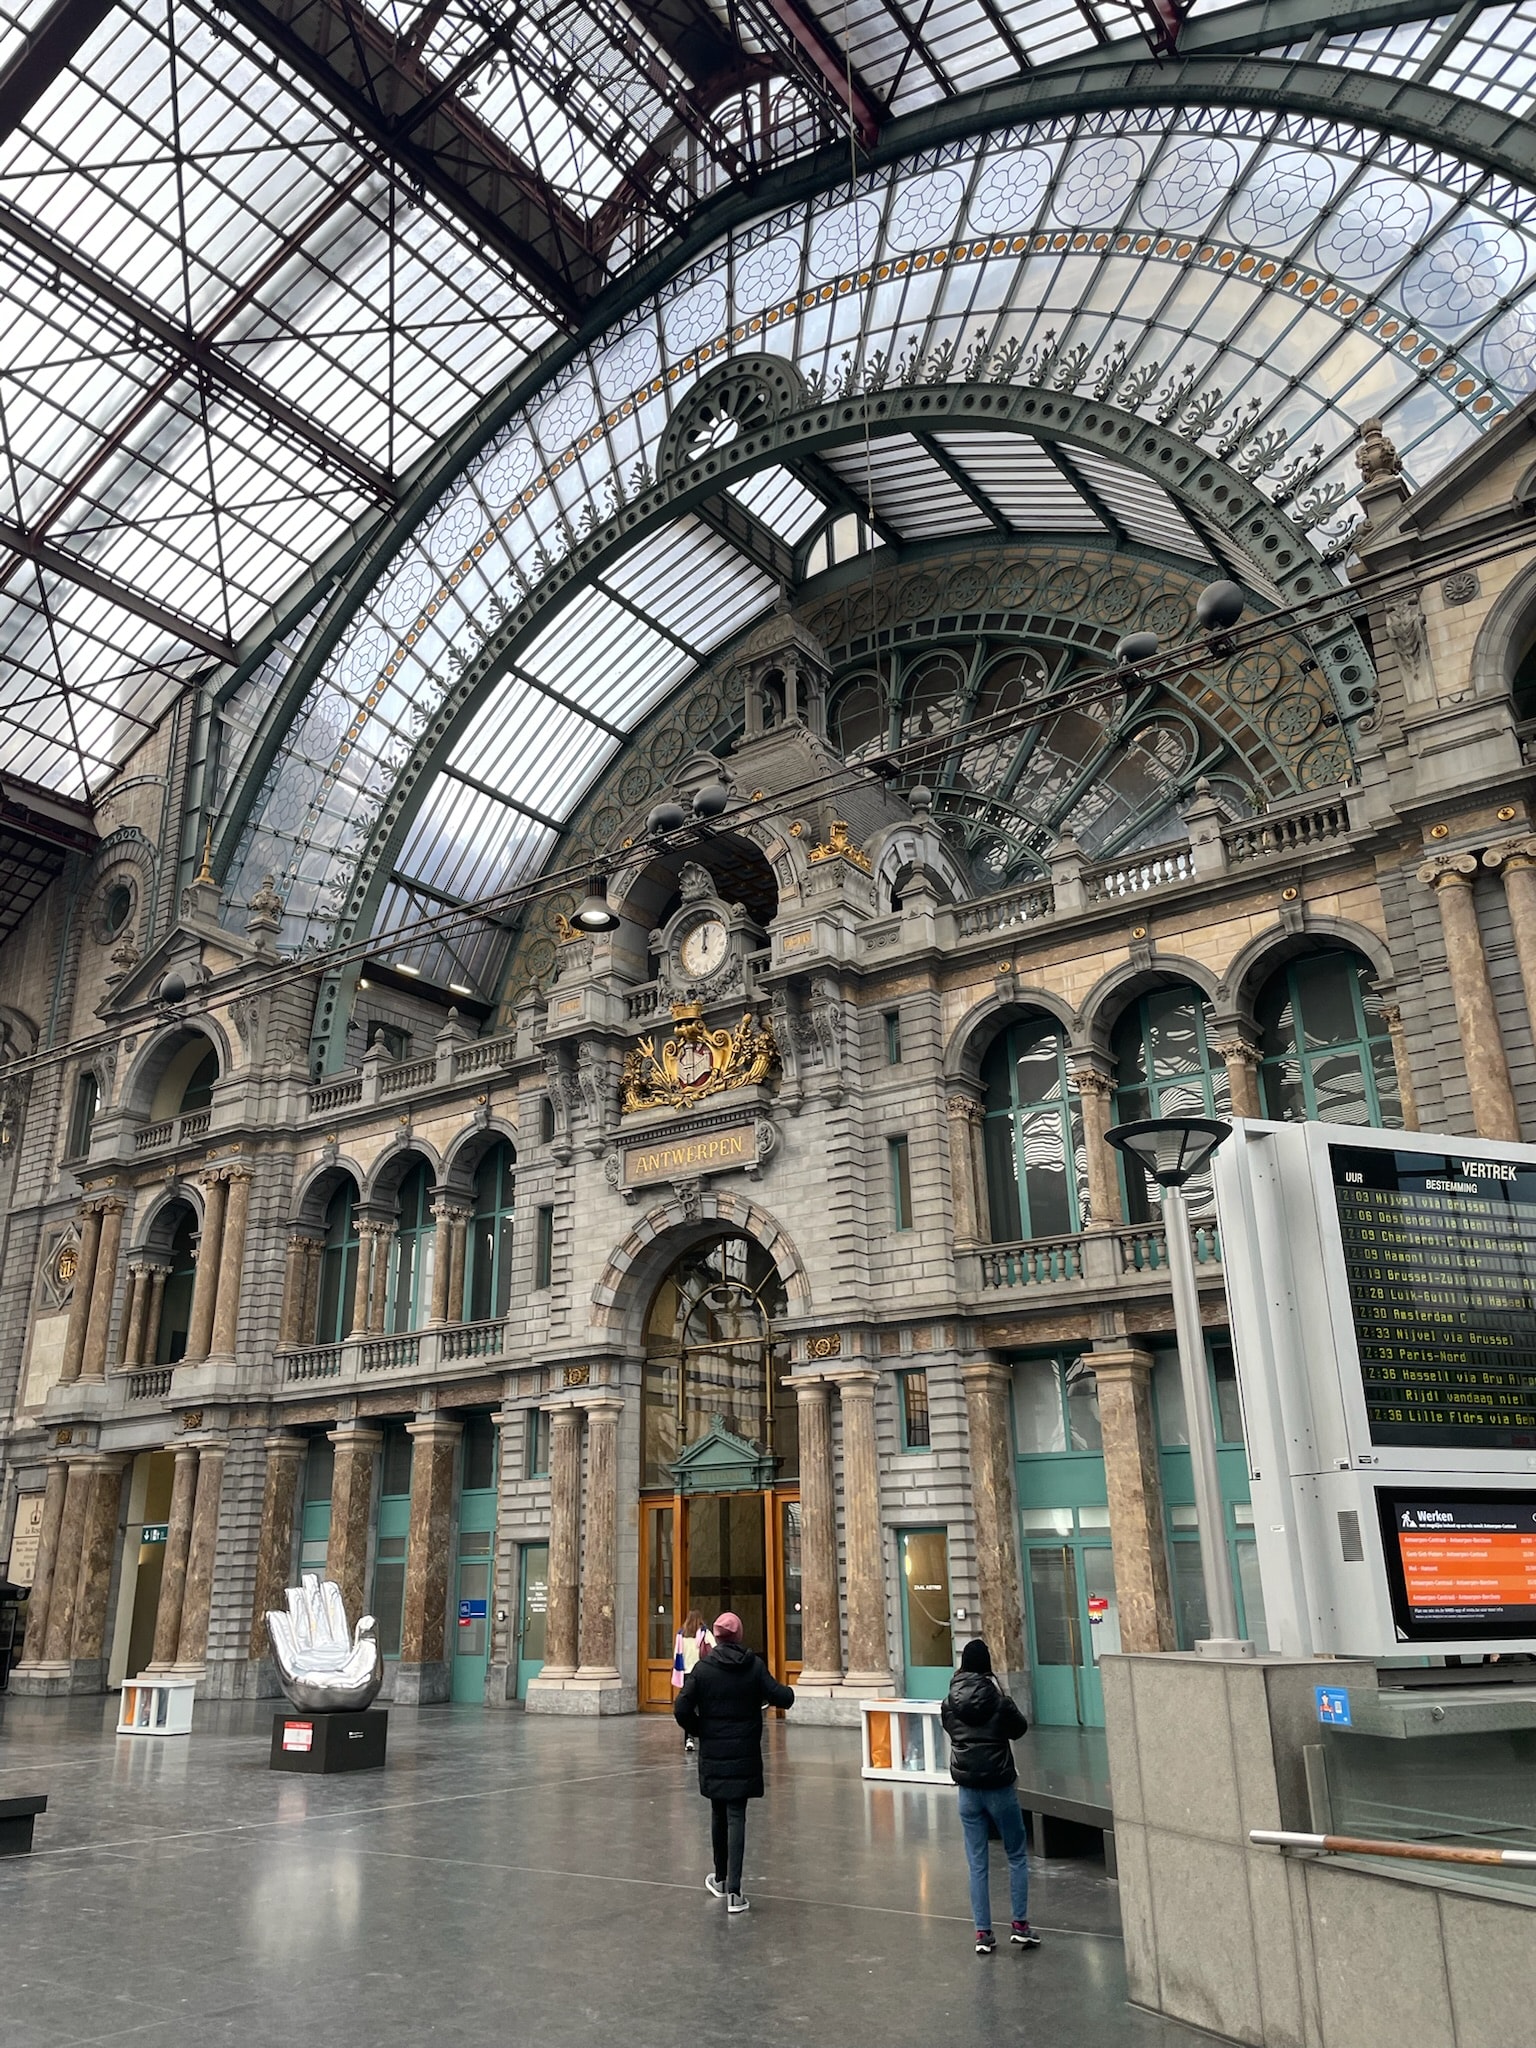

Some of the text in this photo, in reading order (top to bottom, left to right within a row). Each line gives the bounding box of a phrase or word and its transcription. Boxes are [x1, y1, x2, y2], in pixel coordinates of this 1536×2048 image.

[635, 1135, 742, 1174] ANTWERPEN
[1461, 1161, 1517, 1181] VERTREK
[1345, 1171, 1478, 1194] UUR BESTEMMING
[1375, 1193, 1414, 1206] Nijvel
[1421, 1198, 1440, 1210] via
[1447, 1199, 1491, 1214] Brussel
[1378, 1212, 1431, 1226] Oostende
[1437, 1218, 1457, 1229] via
[1460, 1238, 1479, 1248] via
[1485, 1239, 1528, 1253] Brussel
[1384, 1250, 1424, 1263] Hamont
[1431, 1253, 1450, 1265] via
[1456, 1255, 1482, 1267] Lier
[1387, 1269, 1466, 1285] Brussel-Zuid
[1472, 1276, 1492, 1287] via
[1463, 1294, 1483, 1305] via
[1393, 1309, 1453, 1323] Amsterdam
[1460, 1312, 1467, 1324] C
[1396, 1329, 1436, 1342] Nijvel
[1443, 1331, 1463, 1343] via
[1469, 1333, 1514, 1345] Brussel
[1399, 1349, 1467, 1363] Paris-Nord
[1402, 1369, 1450, 1382] Hasselt
[1456, 1372, 1477, 1383] via
[1482, 1372, 1503, 1384] Bru
[1405, 1389, 1525, 1406] Rijdt vandaag niet
[1408, 1410, 1443, 1422] Lille
[1449, 1411, 1484, 1424] Fldrs
[1489, 1413, 1510, 1424] via
[1416, 1510, 1454, 1522] Werken
